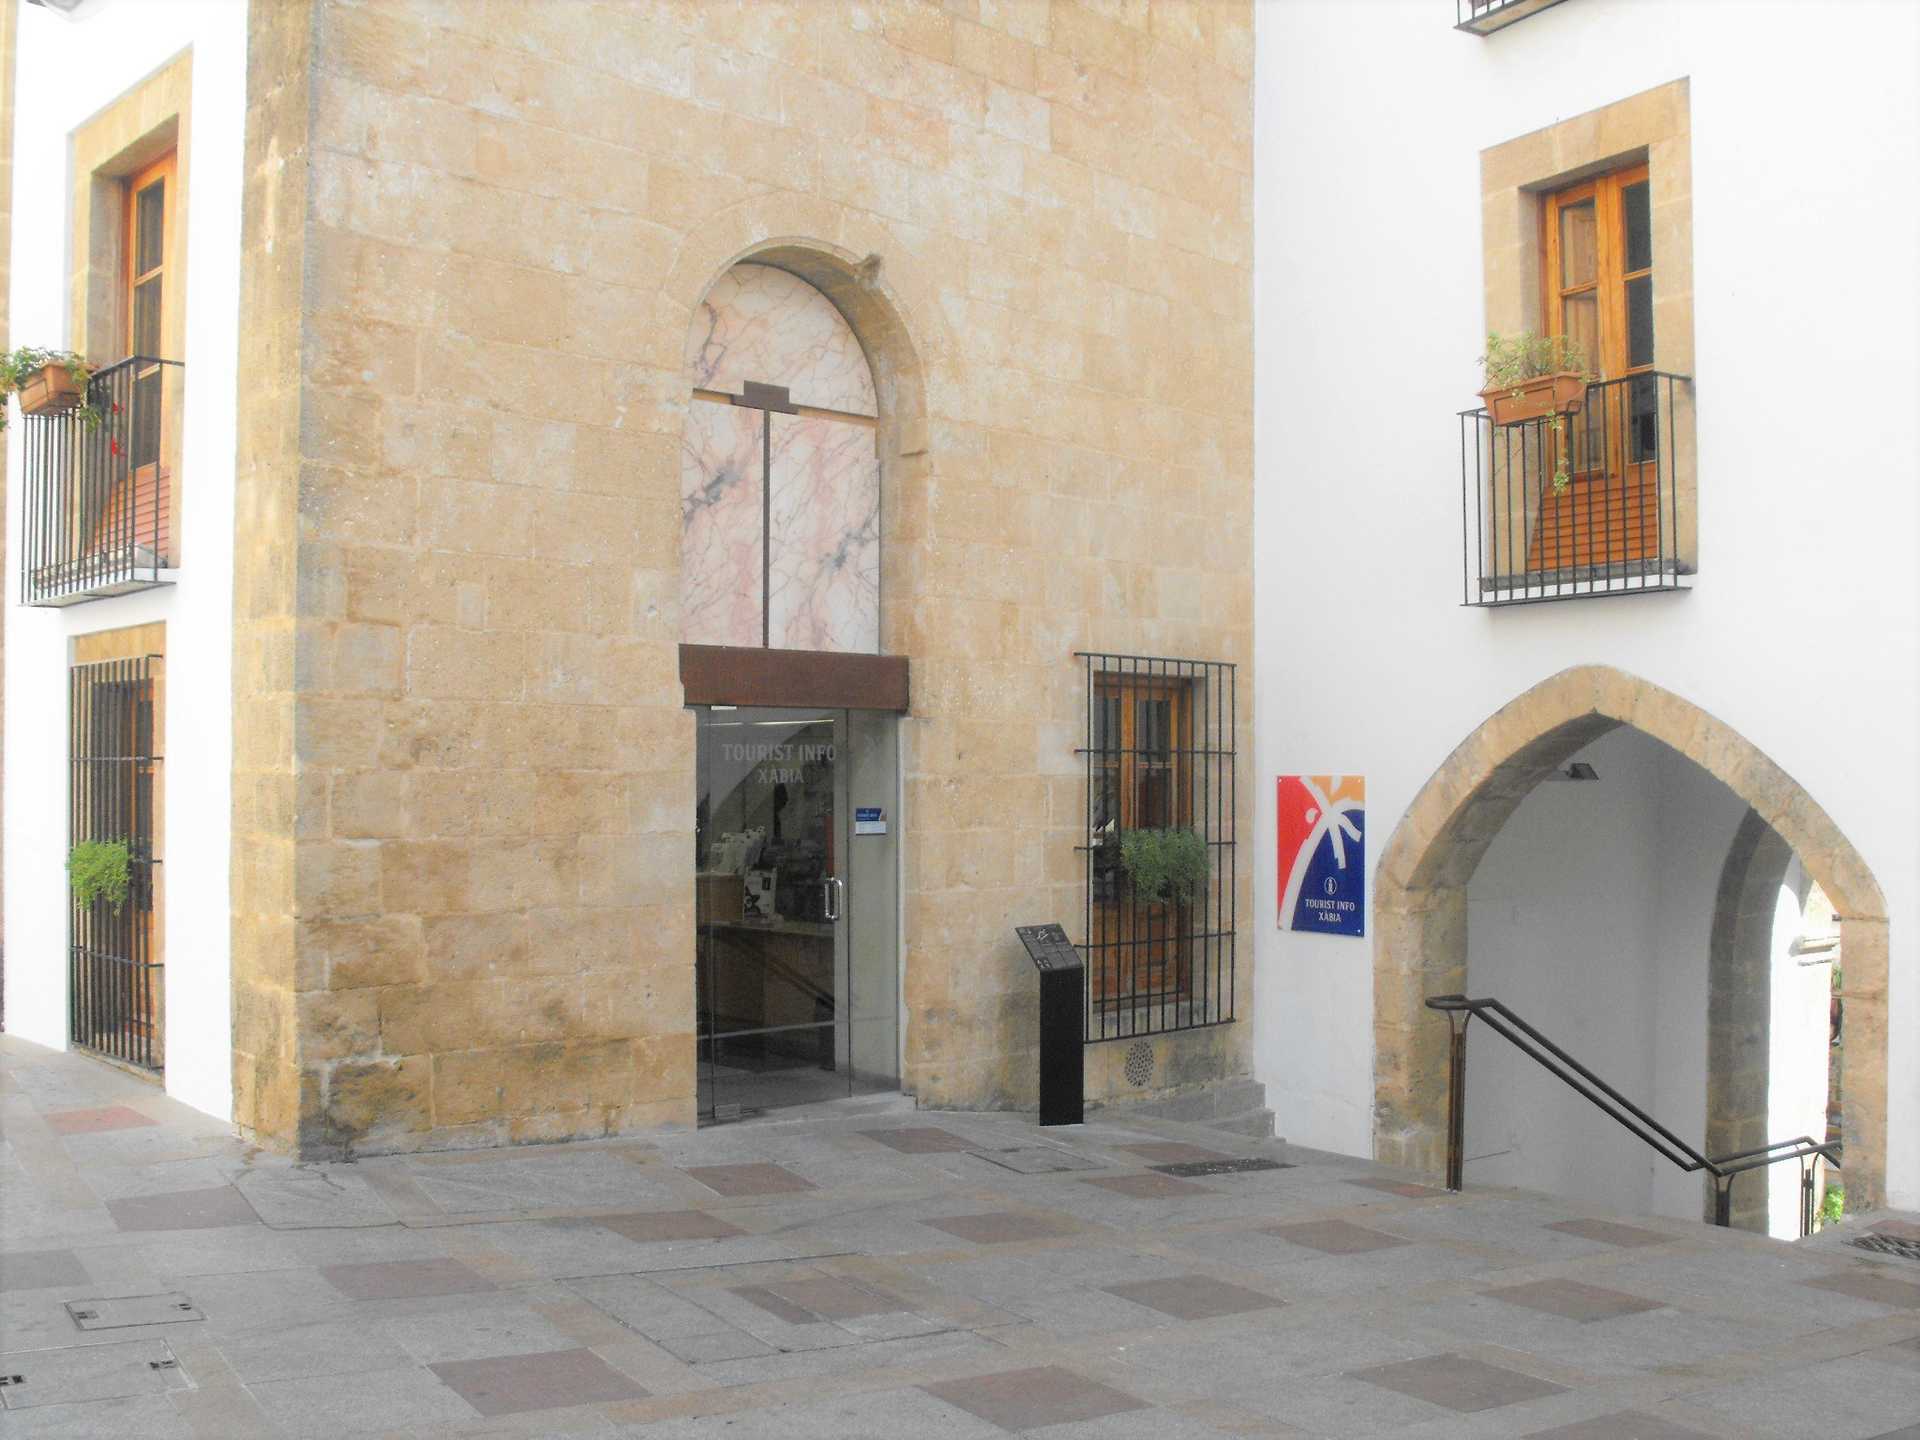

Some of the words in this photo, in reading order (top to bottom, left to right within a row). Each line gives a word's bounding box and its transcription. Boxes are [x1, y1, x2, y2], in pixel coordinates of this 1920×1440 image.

[722, 744, 794, 761] TOURIST
[799, 744, 837, 761] INFO
[1305, 898, 1335, 909] TOURIST
[1337, 901, 1355, 911] INFO
